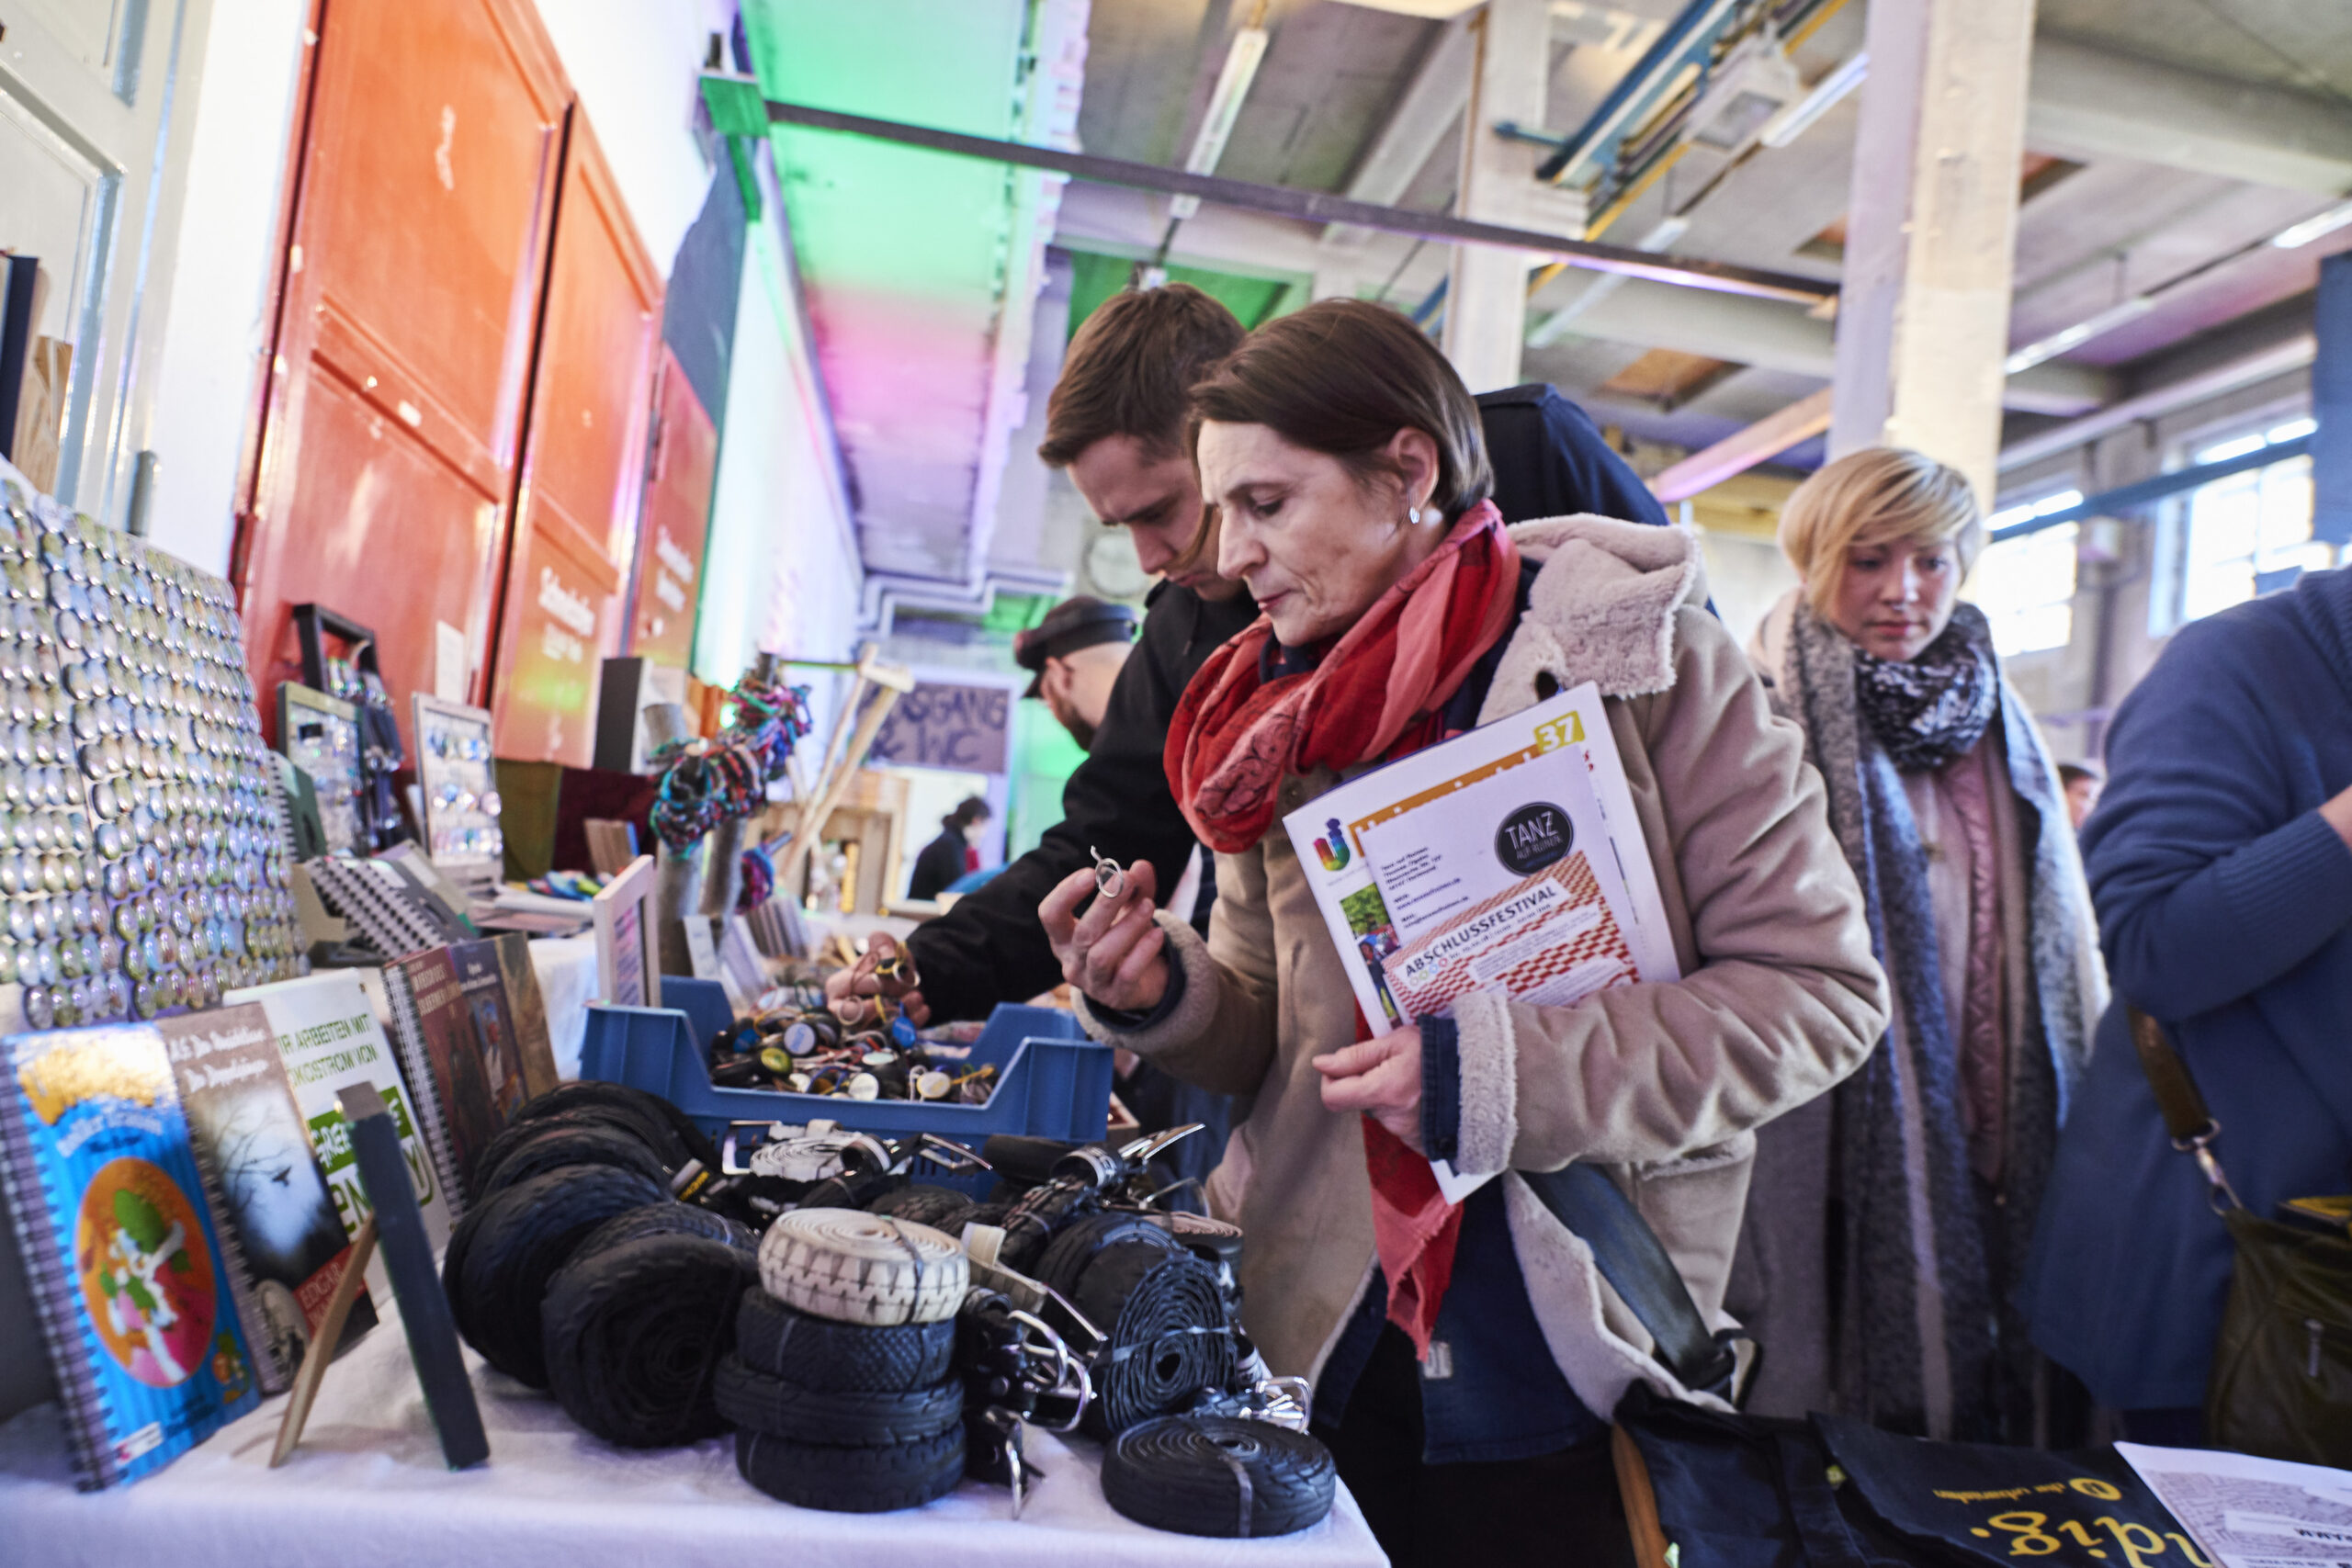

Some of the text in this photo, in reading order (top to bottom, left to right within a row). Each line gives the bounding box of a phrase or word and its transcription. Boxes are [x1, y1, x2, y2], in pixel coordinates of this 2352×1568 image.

[1538, 716, 1575, 751] 37
[1505, 810, 1559, 851] TANZ
[1406, 886, 1557, 977] ABSCHLUSSFESTIVAL
[294, 1020, 352, 1051] ARBEITEN
[350, 1013, 371, 1035] MIT
[356, 1043, 379, 1066] VON
